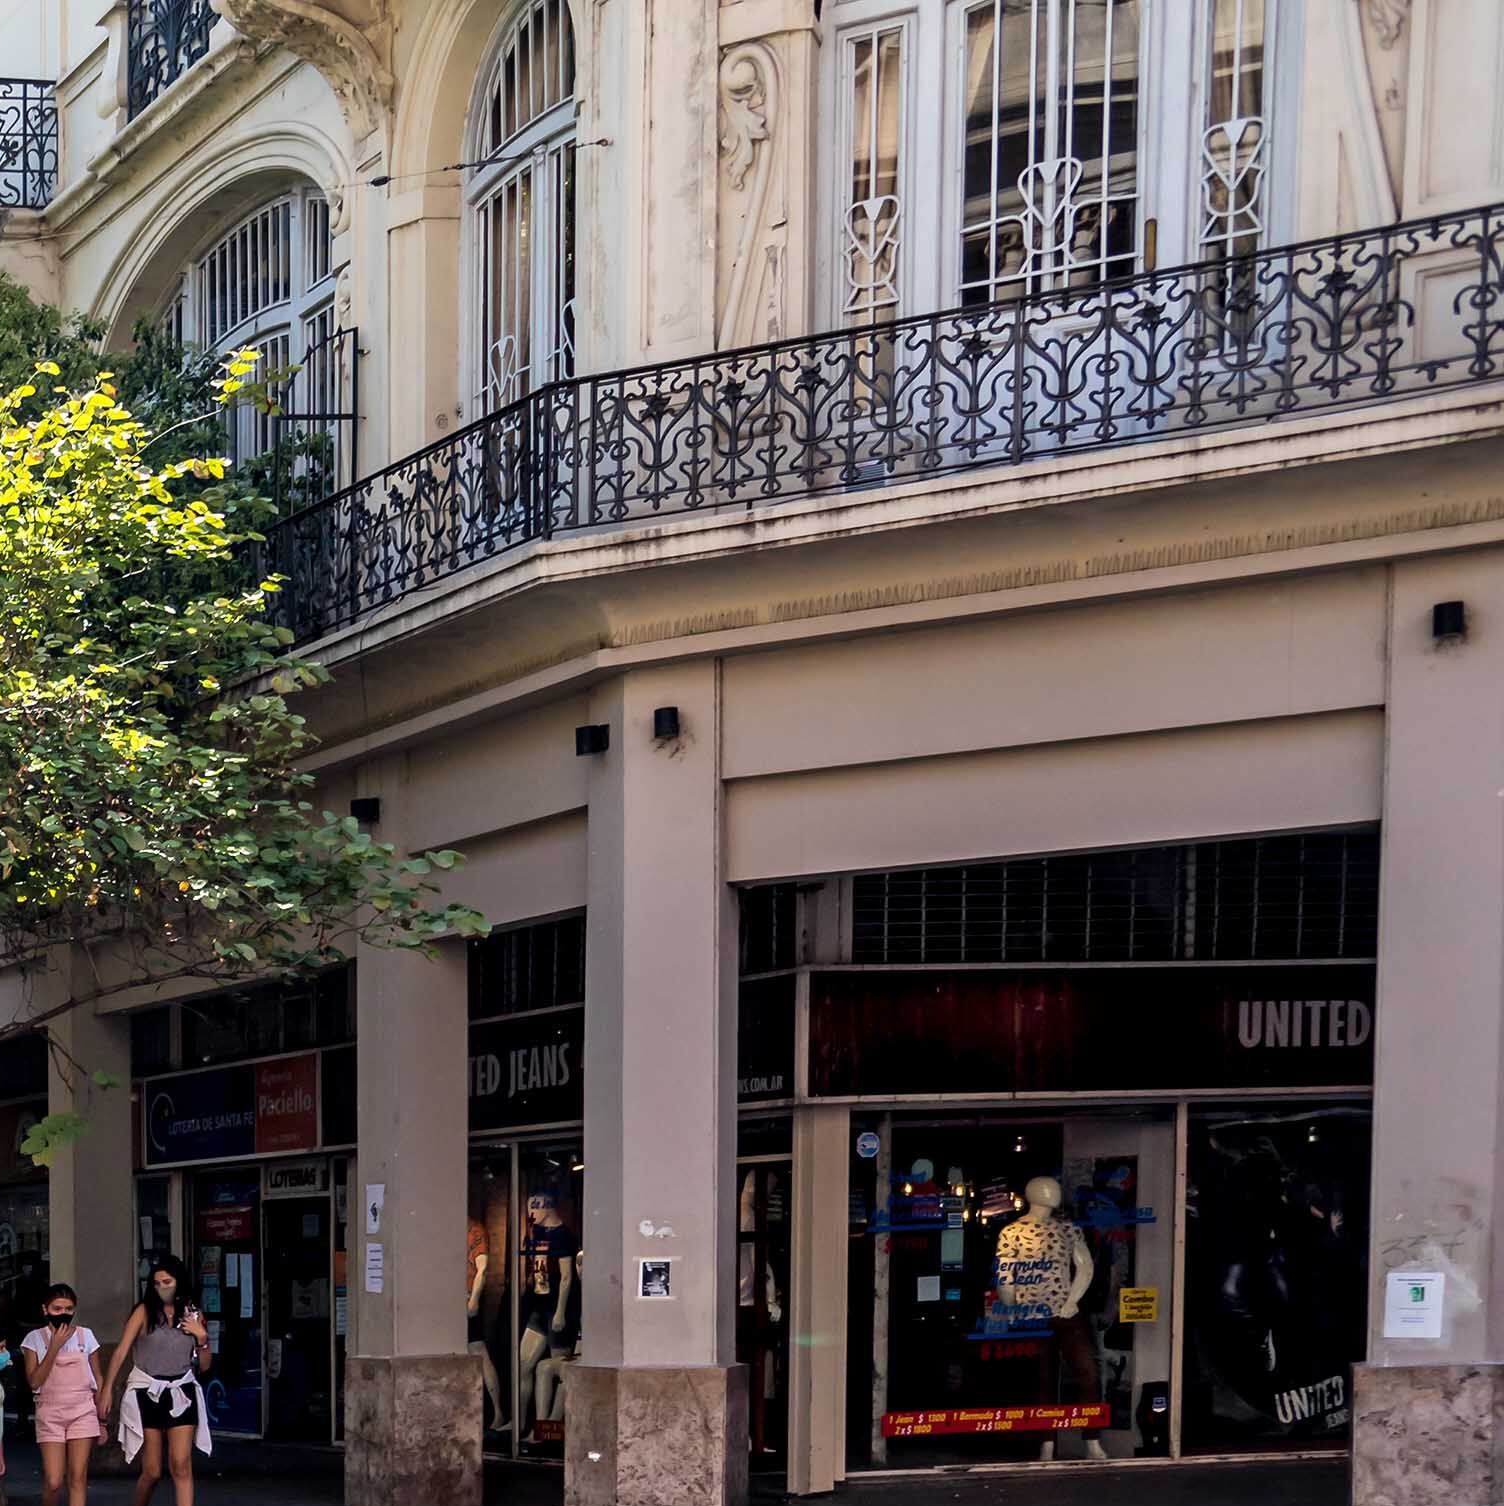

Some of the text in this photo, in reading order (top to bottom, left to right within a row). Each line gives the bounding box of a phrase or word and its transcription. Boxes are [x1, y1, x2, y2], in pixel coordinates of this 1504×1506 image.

[1237, 999, 1371, 1049] UNITED
[507, 1042, 570, 1099] JEANS
[202, 1115, 213, 1132] DE
[214, 1112, 242, 1131] SANTA
[243, 1111, 255, 1129] FE
[258, 1088, 313, 1119] Paciello
